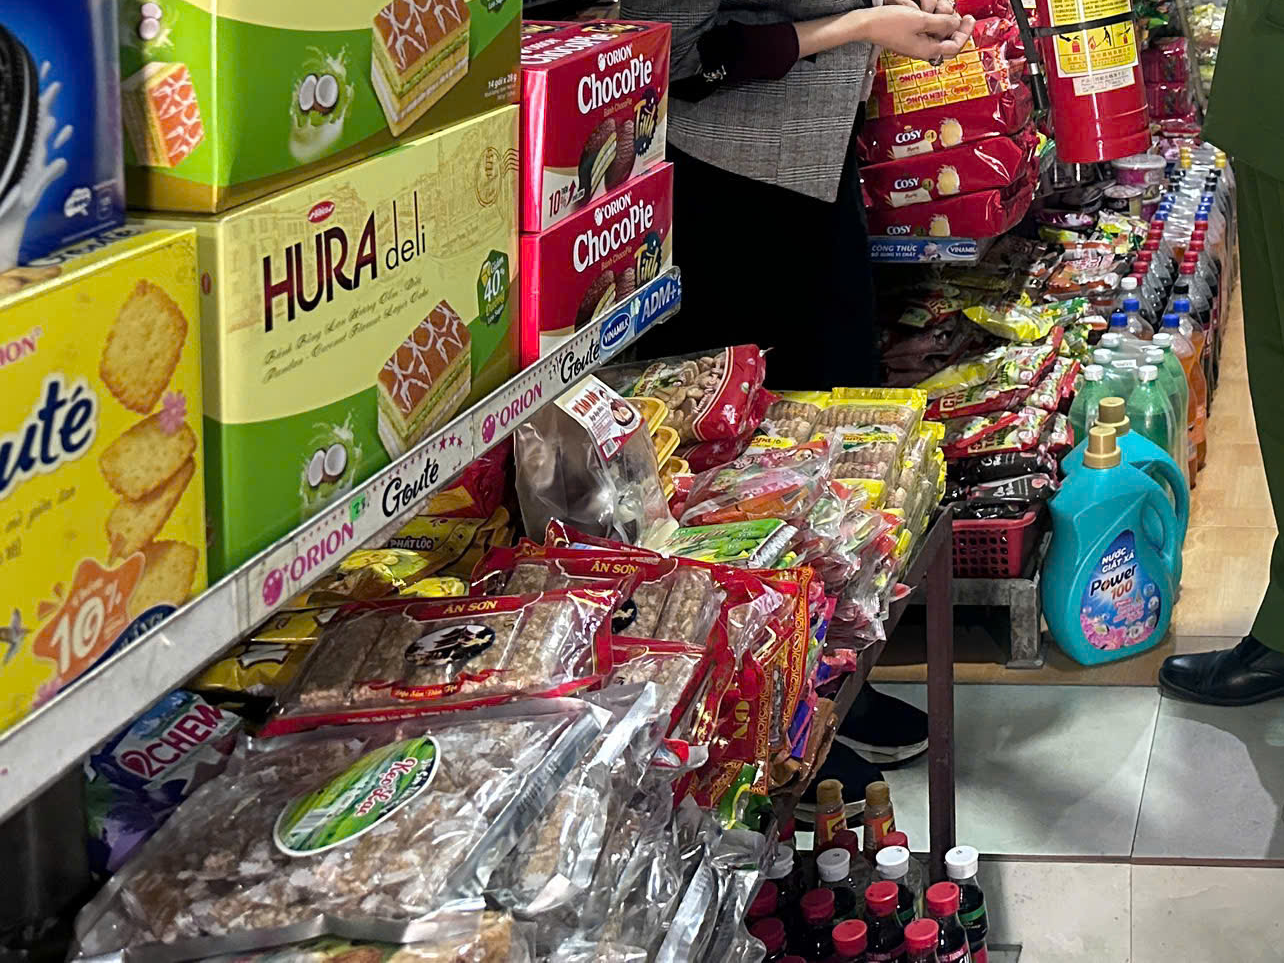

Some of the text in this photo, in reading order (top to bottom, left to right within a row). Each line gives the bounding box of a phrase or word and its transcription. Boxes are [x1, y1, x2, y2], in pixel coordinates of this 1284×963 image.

[606, 45, 632, 67] ORION
[577, 54, 653, 115] ChocoPie
[895, 129, 922, 144] COSY
[894, 177, 919, 190] COSY
[604, 195, 632, 219] ORION
[573, 200, 653, 273] ChocoPie
[886, 224, 911, 236] COSY
[872, 243, 976, 254] CÔNG THỨC VINAMIL
[263, 210, 377, 333] HURA
[386, 191, 425, 270] deli
[500, 381, 543, 427] ORION
[561, 339, 600, 384] Gouté
[603, 316, 629, 344] VINAMILK
[642, 281, 677, 323] ADM+
[0, 381, 92, 492] uté
[290, 457, 439, 581] ORION Gouté
[1101, 547, 1127, 565] NƯỚC
[1102, 558, 1124, 573] GIẶT
[1090, 564, 1137, 597] Power
[1112, 580, 1133, 600] 100
